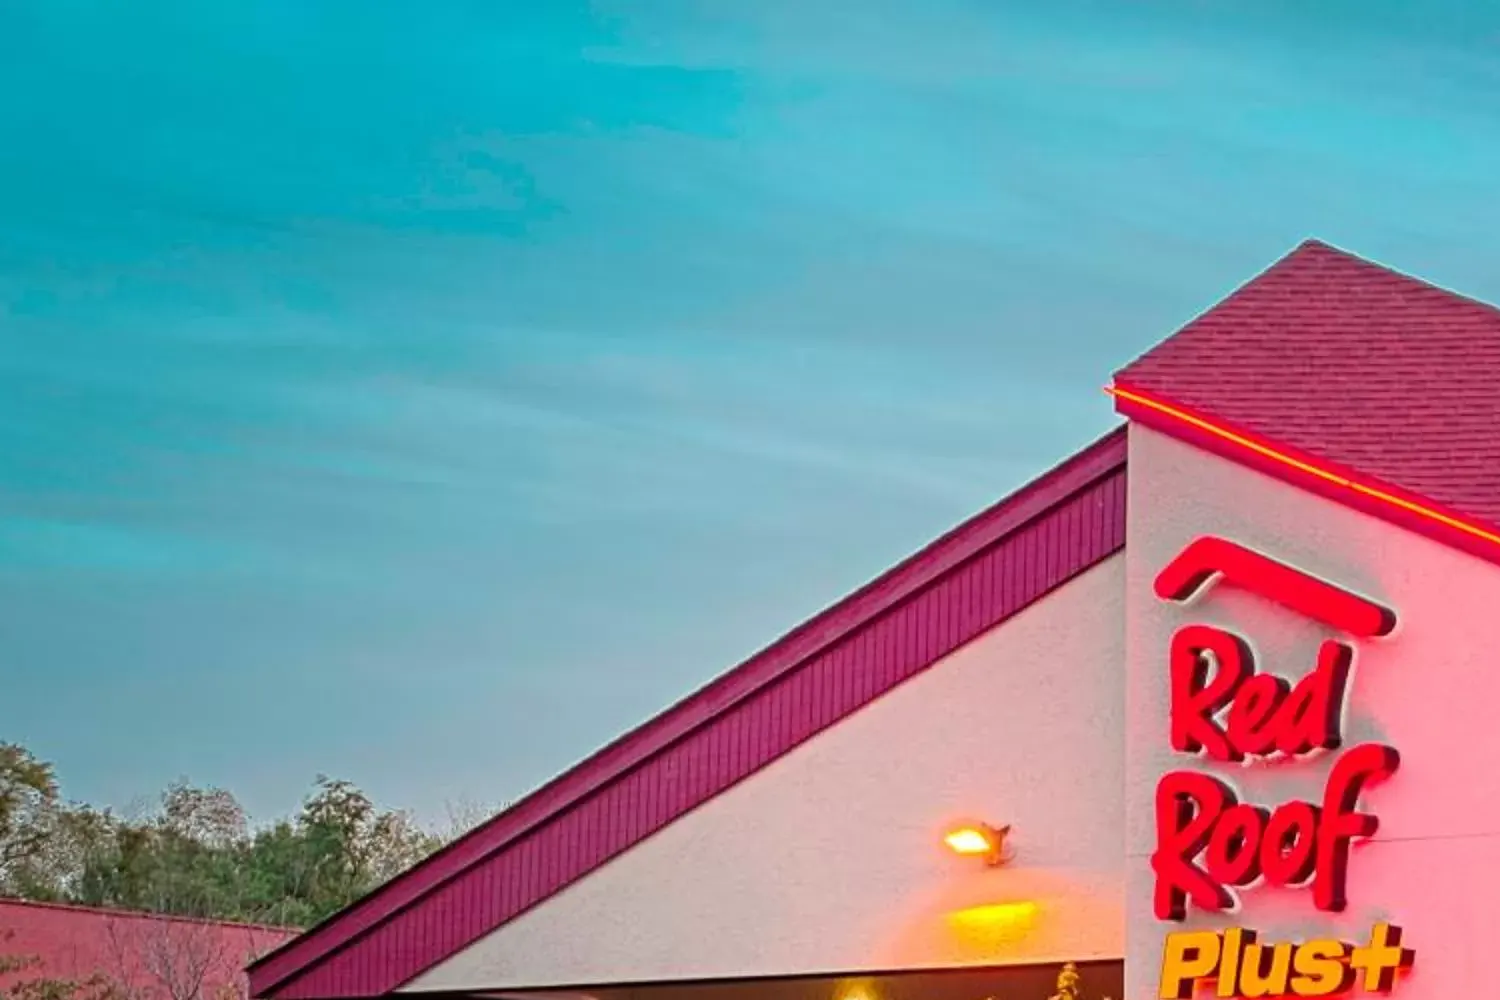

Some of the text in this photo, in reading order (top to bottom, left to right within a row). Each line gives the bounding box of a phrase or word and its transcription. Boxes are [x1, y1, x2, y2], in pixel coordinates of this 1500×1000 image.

[1170, 625, 1351, 762] Red
[1152, 743, 1400, 920] Roof
[1160, 923, 1413, 1000] Plus+
